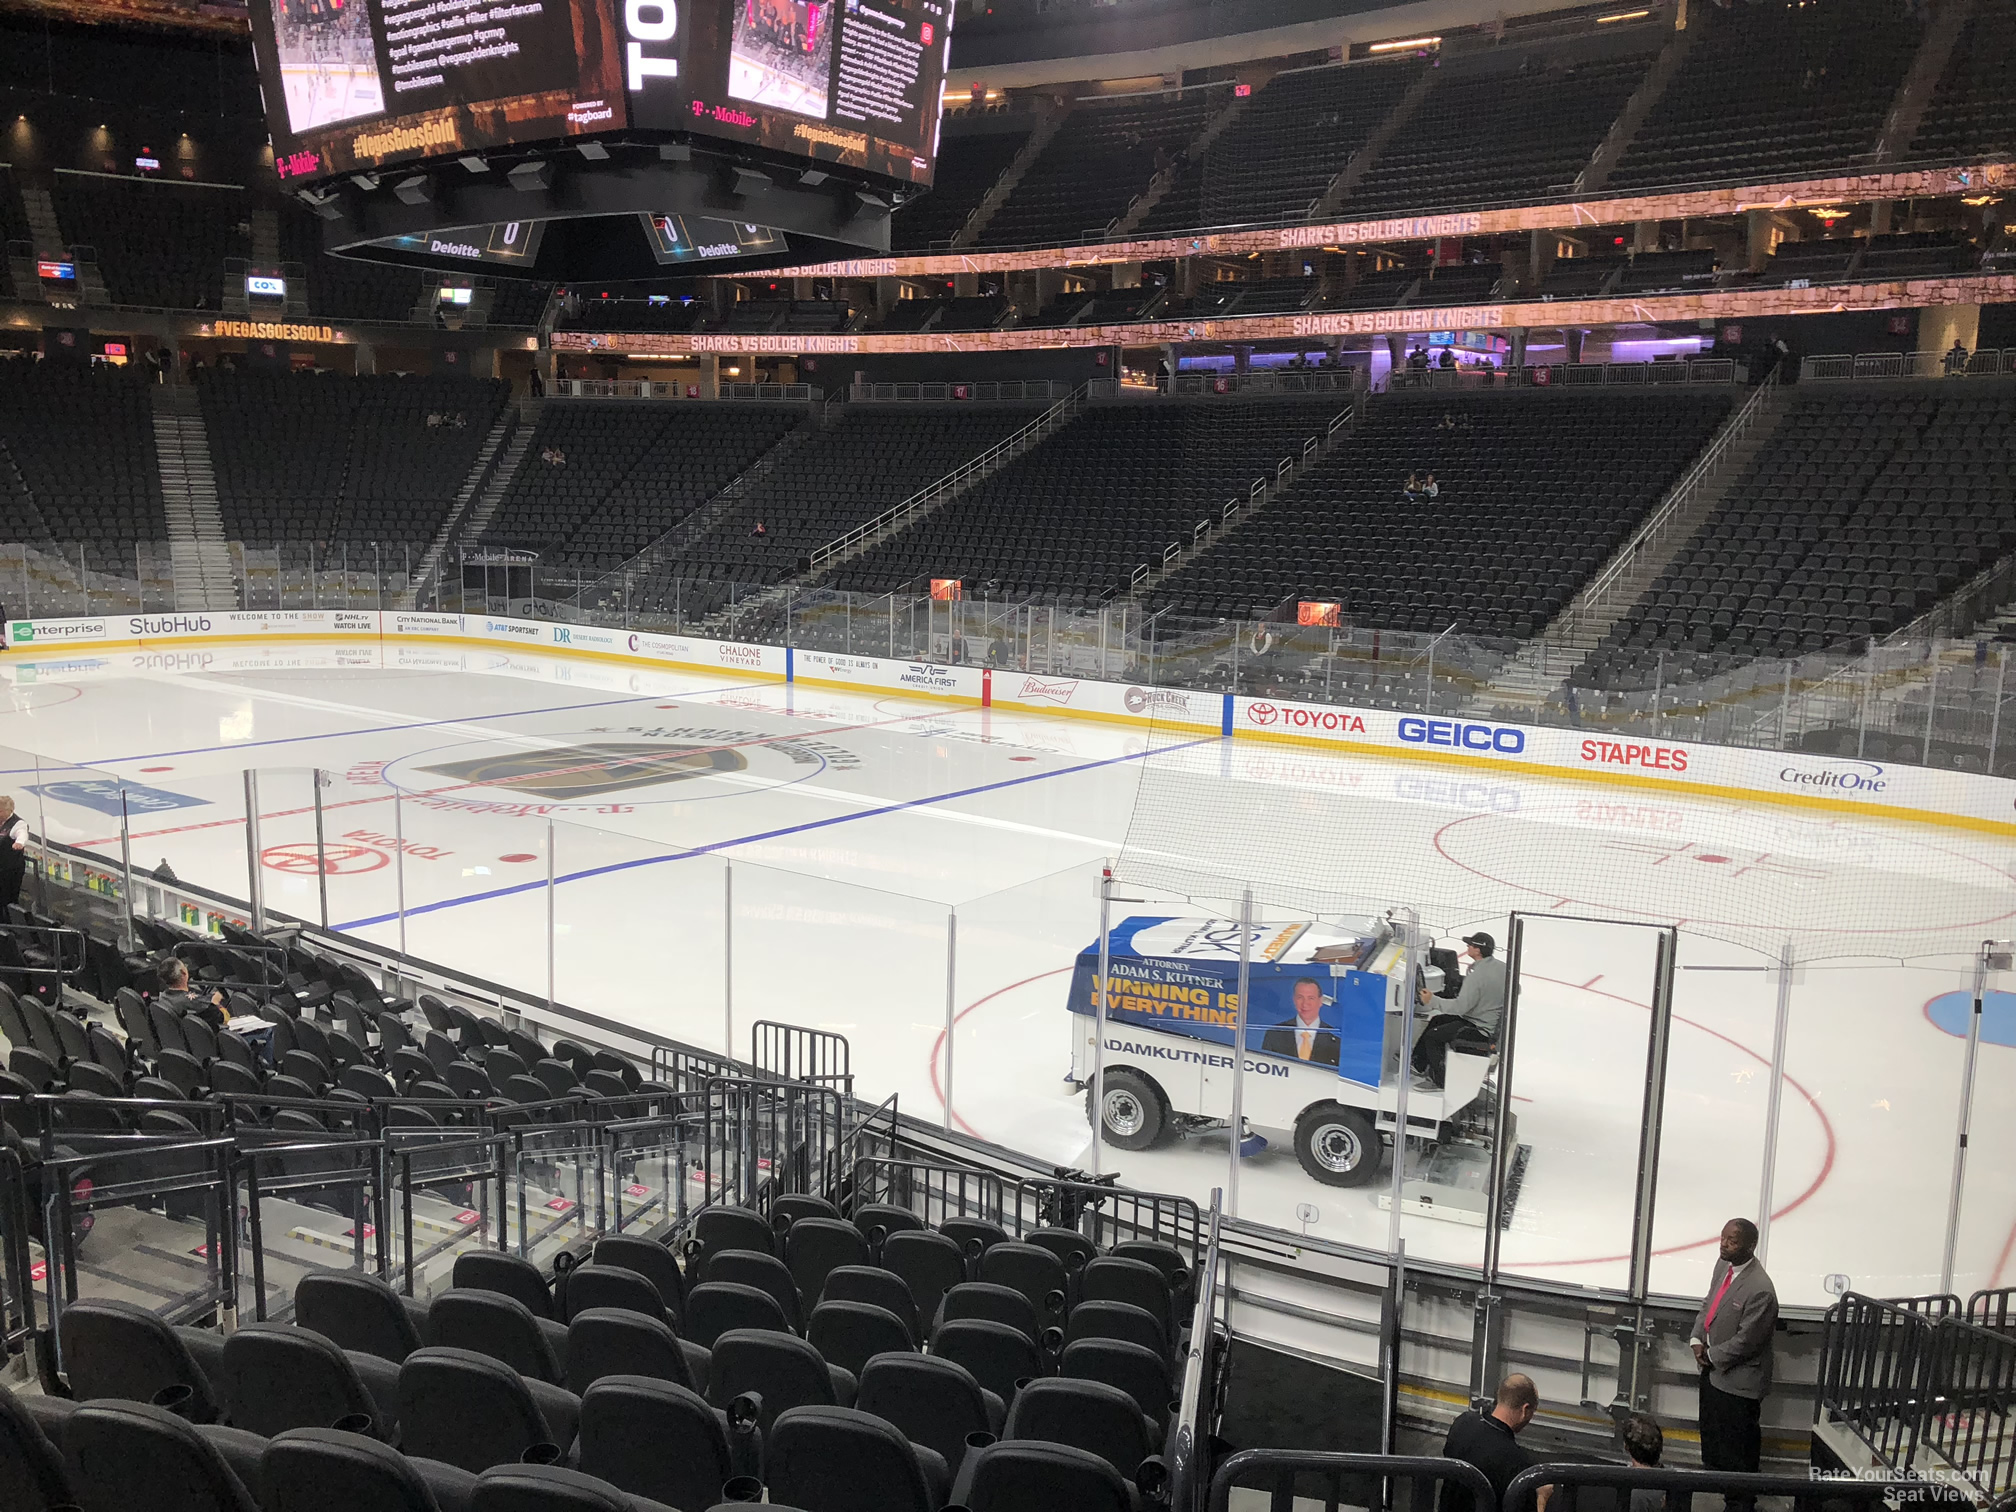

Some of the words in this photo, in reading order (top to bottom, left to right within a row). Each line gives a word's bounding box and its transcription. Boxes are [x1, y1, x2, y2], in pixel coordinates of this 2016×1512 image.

[567, 107, 612, 124] #tagboard
[353, 118, 456, 158] #VegasGoesGold
[793, 123, 867, 152] #VegasGoesGold
[1280, 228, 1334, 247] SHARKS
[1337, 224, 1357, 243] VS
[1358, 219, 1413, 241] GOLDEN
[1416, 213, 1480, 237] KNIGHTS
[849, 259, 897, 274] KNIGHTS
[1293, 315, 1350, 335] SHARKS
[1352, 314, 1374, 332] VS
[1375, 310, 1431, 331] GOLDEN
[1433, 307, 1503, 329] KNIGHTS
[214, 320, 332, 342] #VEGASGOESGOLD
[691, 336, 739, 351] SHARKS
[741, 336, 759, 351] VS
[759, 335, 805, 351] GOLDEN
[809, 335, 859, 351] KNIGHTS
[14, 623, 103, 637] enterprise
[130, 616, 211, 634] StubHub
[494, 624, 508, 632] AT&T
[508, 625, 539, 636] SPORTSNET
[553, 627, 571, 643] DR
[719, 644, 761, 659] CHALONE
[720, 656, 761, 666] VINEYARD
[900, 674, 933, 685] AMERICA
[934, 677, 957, 687] FIRST
[1024, 681, 1072, 697] Budweiser
[1282, 708, 1366, 733] TOYOTA
[1398, 718, 1525, 754] GEICO
[1580, 740, 1688, 771] STAPLES
[1142, 957, 1190, 972] ATTORNEY
[1111, 963, 1150, 980] ADAM
[1152, 969, 1164, 981] S.
[1166, 972, 1224, 990] KUTNER
[1092, 974, 1210, 1006] WINNING
